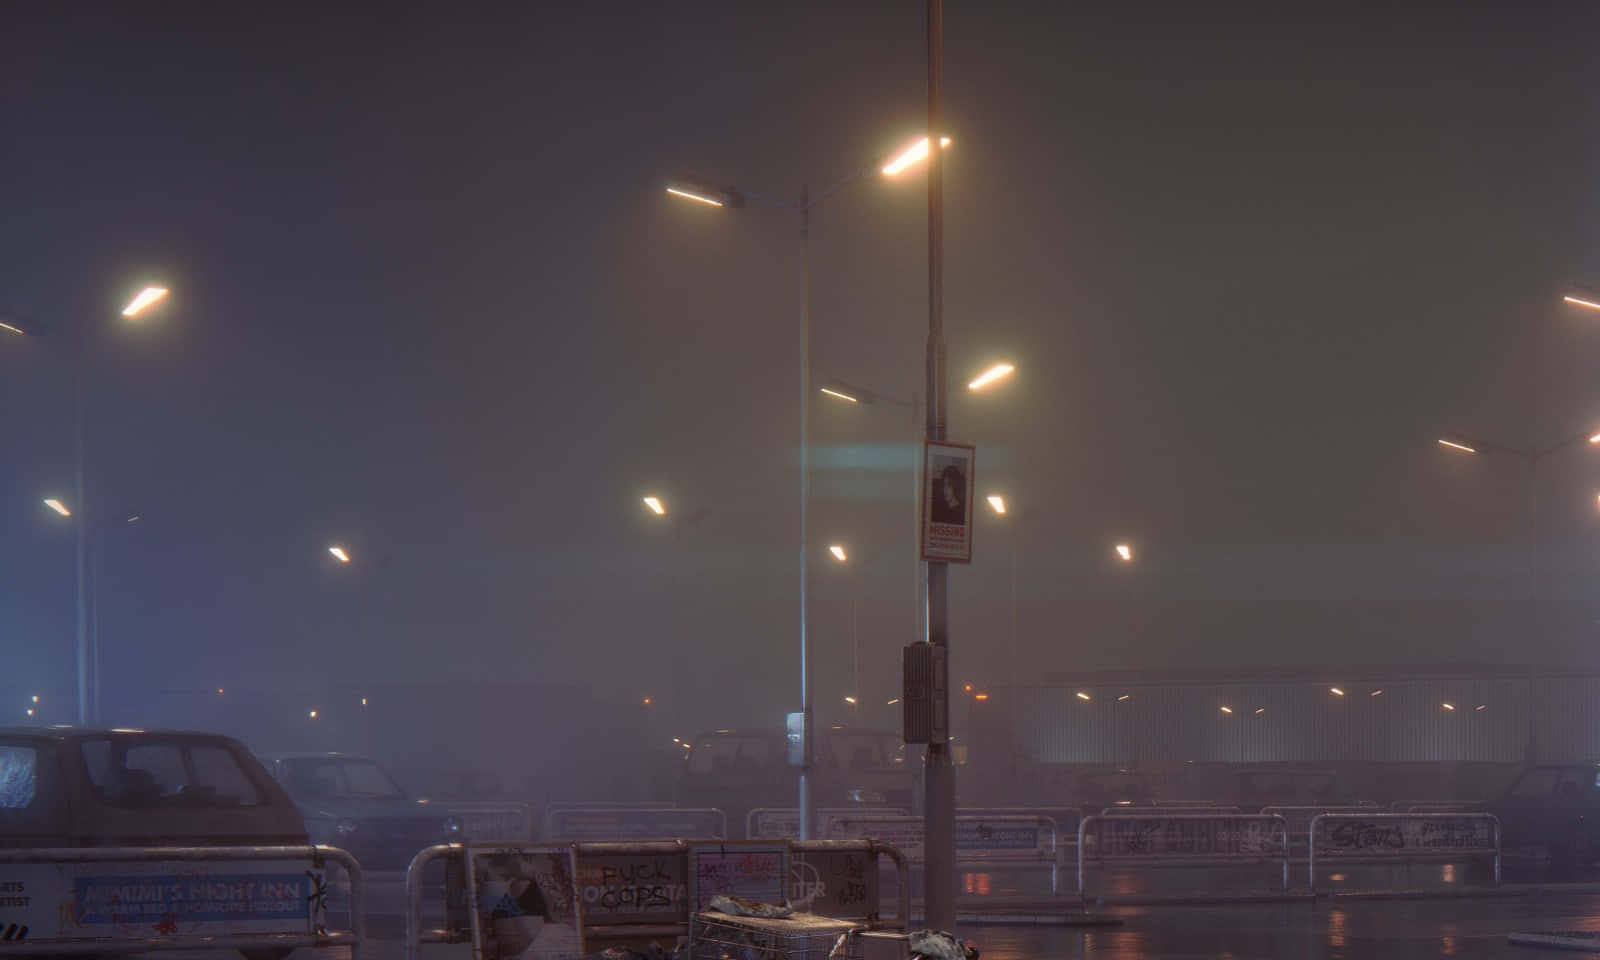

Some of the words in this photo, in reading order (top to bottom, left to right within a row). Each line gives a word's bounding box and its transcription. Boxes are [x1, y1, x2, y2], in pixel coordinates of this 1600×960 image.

[601, 856, 671, 886] FUCK
[261, 882, 300, 899] INN
[601, 885, 671, 909] COPS
